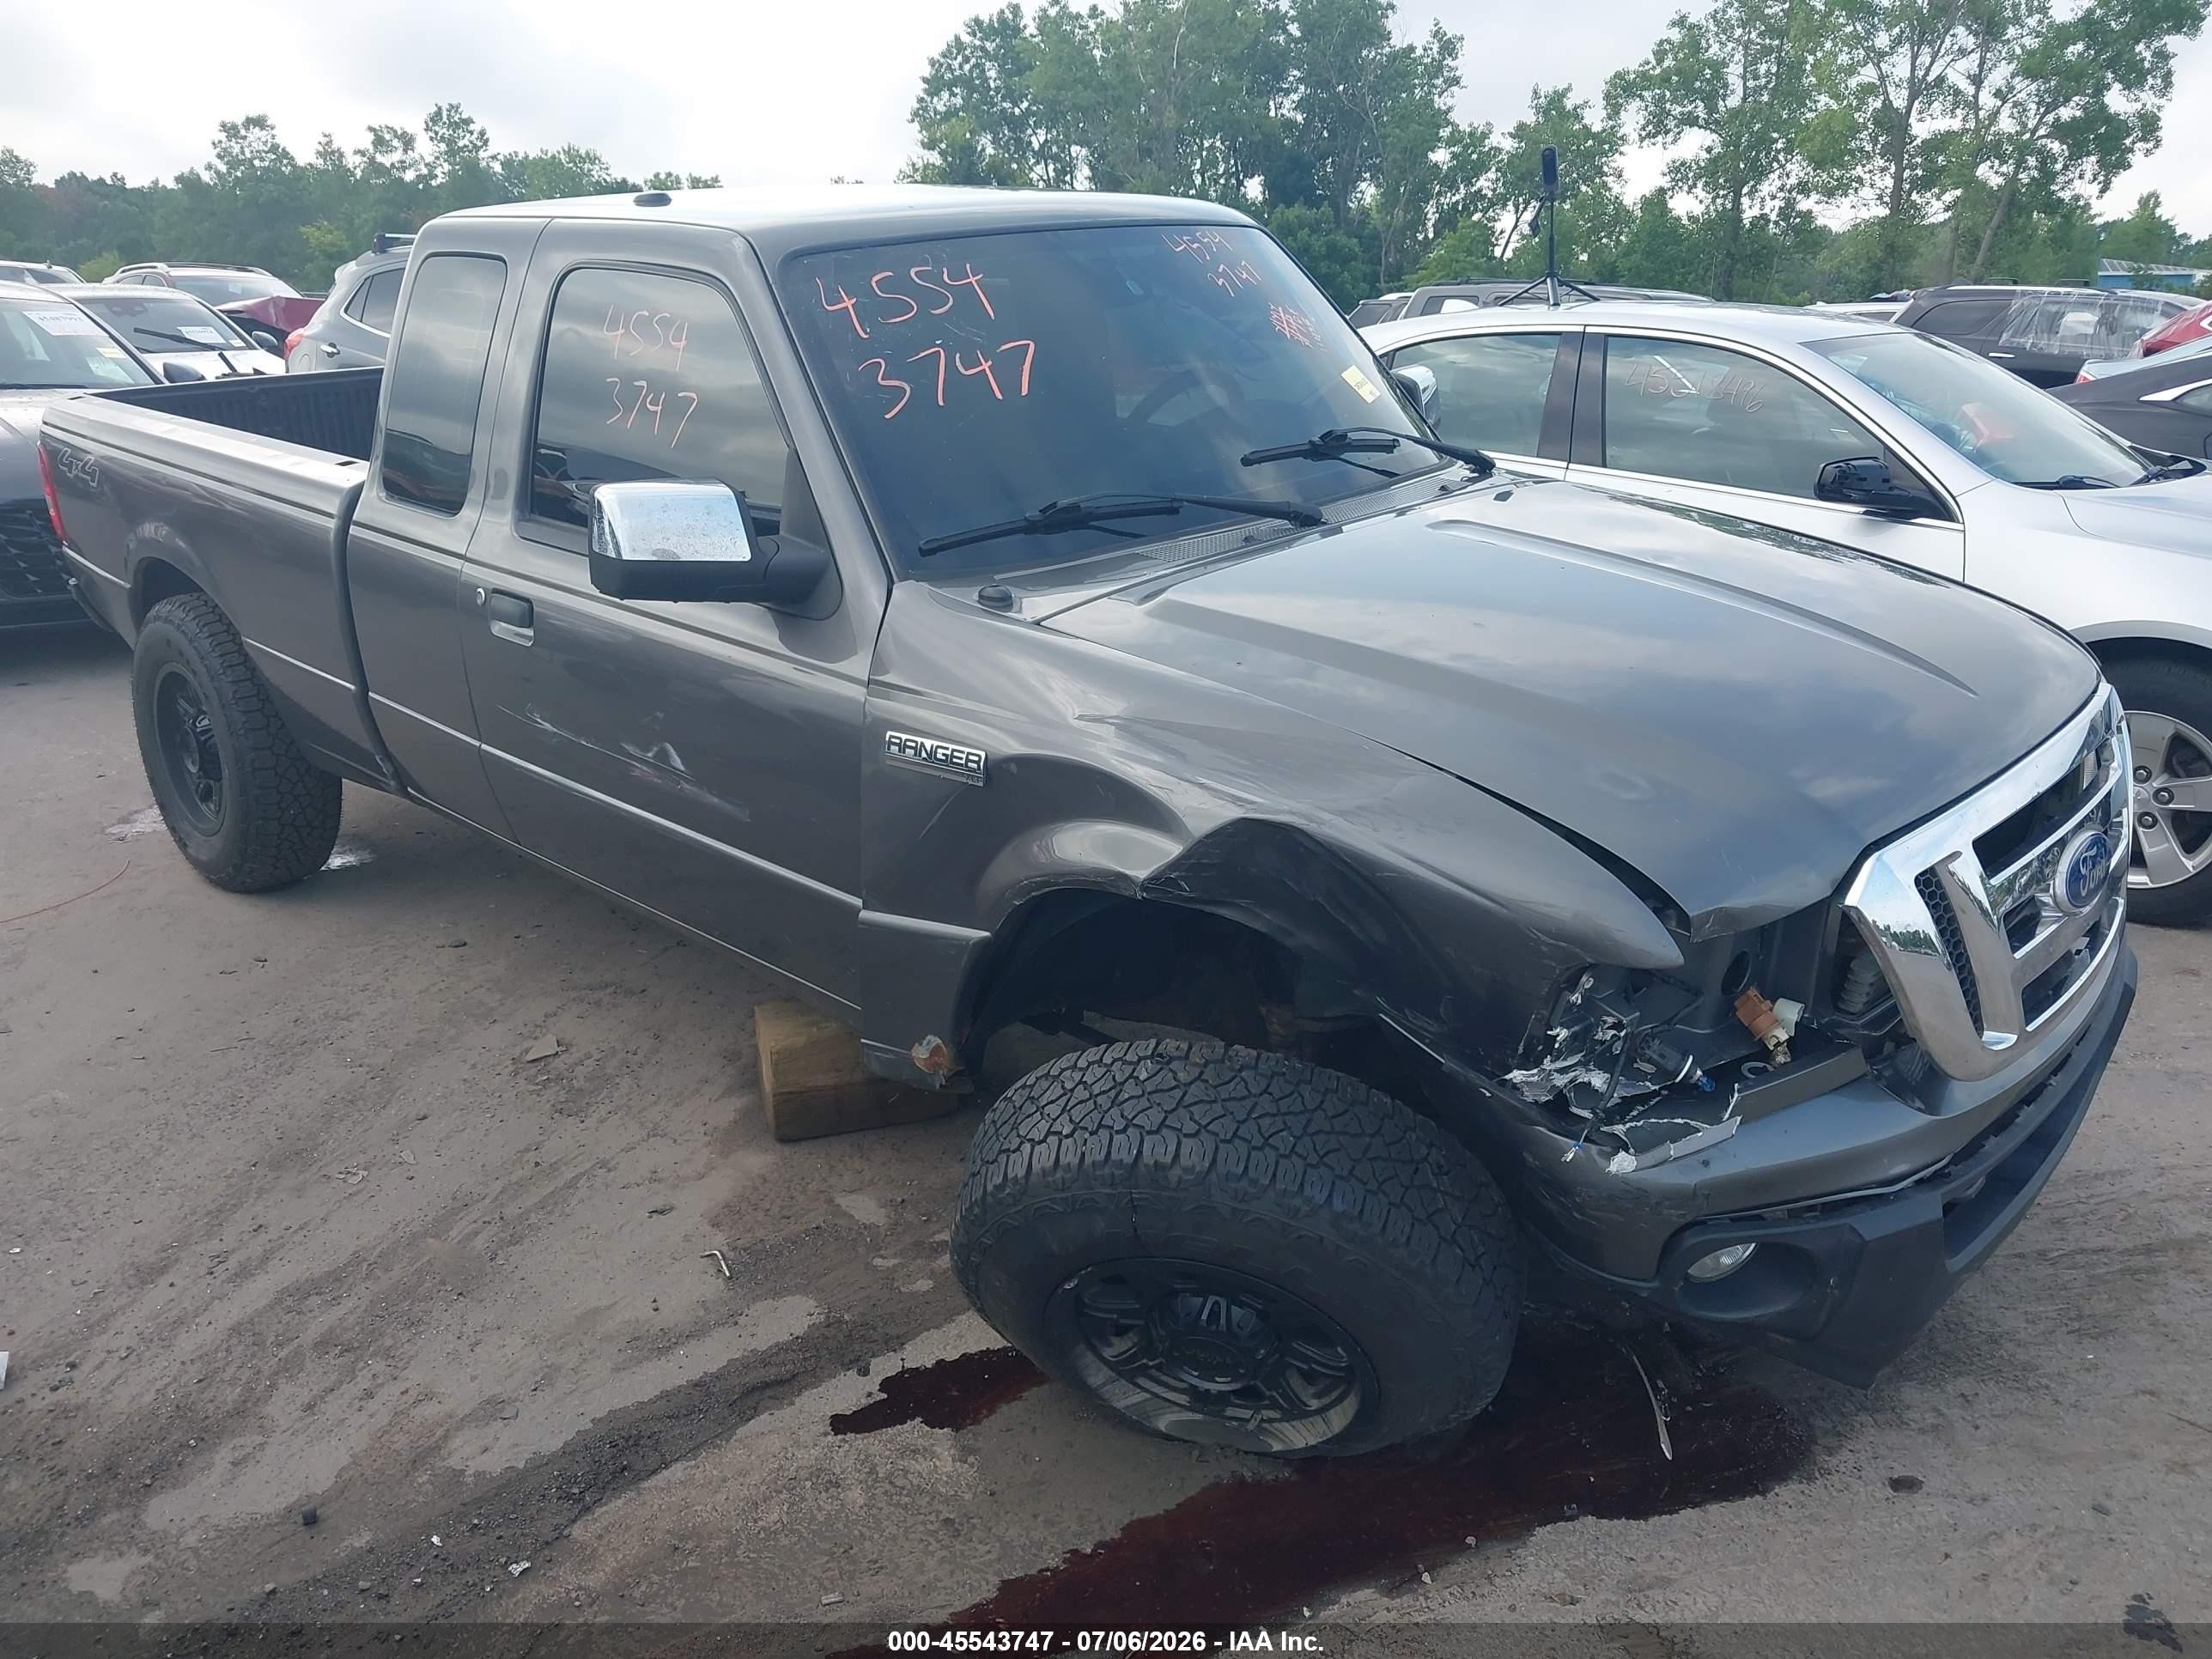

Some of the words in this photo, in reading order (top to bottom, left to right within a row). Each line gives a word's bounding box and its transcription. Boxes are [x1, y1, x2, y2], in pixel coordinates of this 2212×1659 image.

[1161, 230, 1234, 264] 4554
[816, 261, 995, 339] 4554
[1206, 260, 1264, 297] 3747
[604, 304, 689, 371] 4554
[858, 340, 1036, 419] 3747
[605, 377, 699, 448] 3747
[57, 447, 100, 488] 4x4
[886, 734, 983, 772] RANGER
[2079, 843, 2109, 897] Ford
